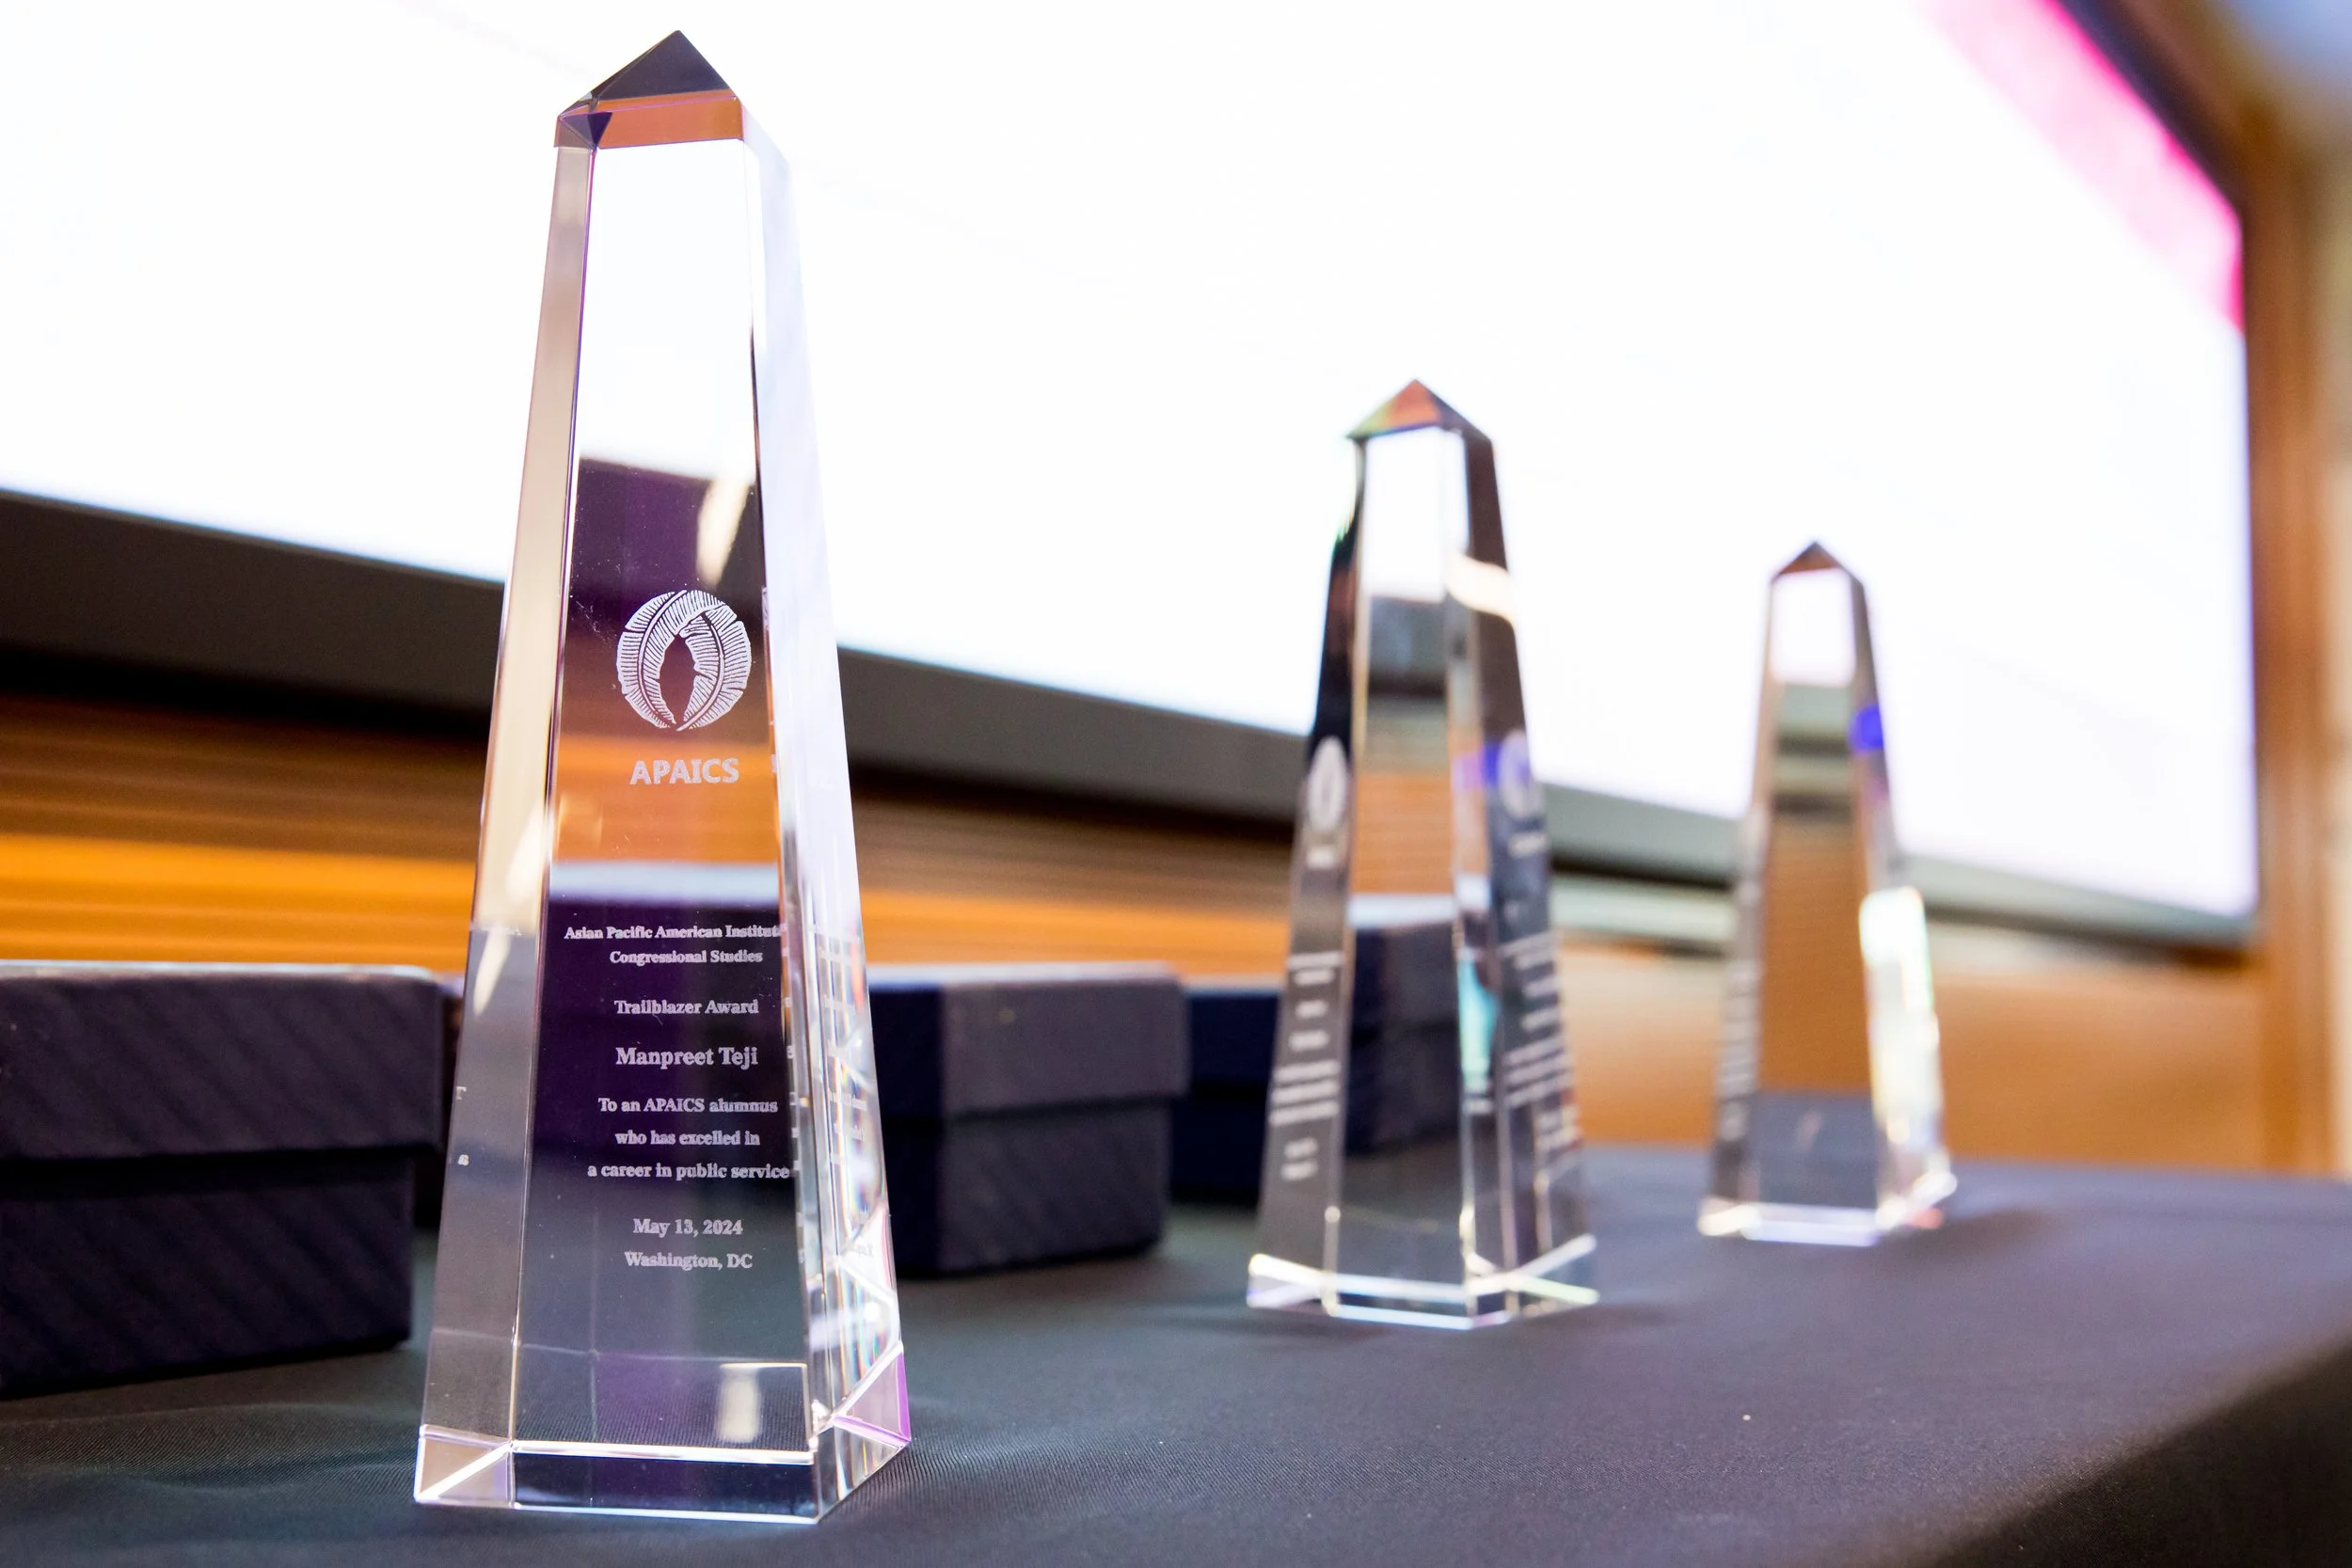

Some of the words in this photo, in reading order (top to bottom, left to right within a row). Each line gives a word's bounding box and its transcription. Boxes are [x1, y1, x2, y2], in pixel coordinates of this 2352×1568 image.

[629, 758, 739, 784] APAICS
[564, 927, 603, 939] Asian
[607, 926, 652, 939] Pacific
[655, 926, 723, 938] American
[610, 950, 707, 966] Congressional
[710, 949, 763, 962] Studies
[614, 1000, 702, 1014] Trailblazer
[705, 999, 759, 1014] Award
[615, 1047, 714, 1069] Manpreet
[719, 1046, 758, 1069] Teji
[598, 1098, 617, 1112] To
[621, 1101, 641, 1112] an
[644, 1098, 705, 1112] APAICS
[709, 1099, 778, 1113] alumnus
[615, 1130, 647, 1145] who
[650, 1130, 675, 1145] has
[679, 1131, 740, 1146] excelled
[744, 1131, 760, 1146] in
[587, 1164, 597, 1177] a
[601, 1165, 652, 1177] career
[656, 1163, 673, 1177] in
[676, 1163, 727, 1180] public
[730, 1164, 789, 1179] service
[633, 1219, 671, 1238] May
[675, 1220, 699, 1237] 13,
[703, 1220, 743, 1235] 2024
[625, 1251, 723, 1271] Washington,
[726, 1254, 753, 1268] DC
